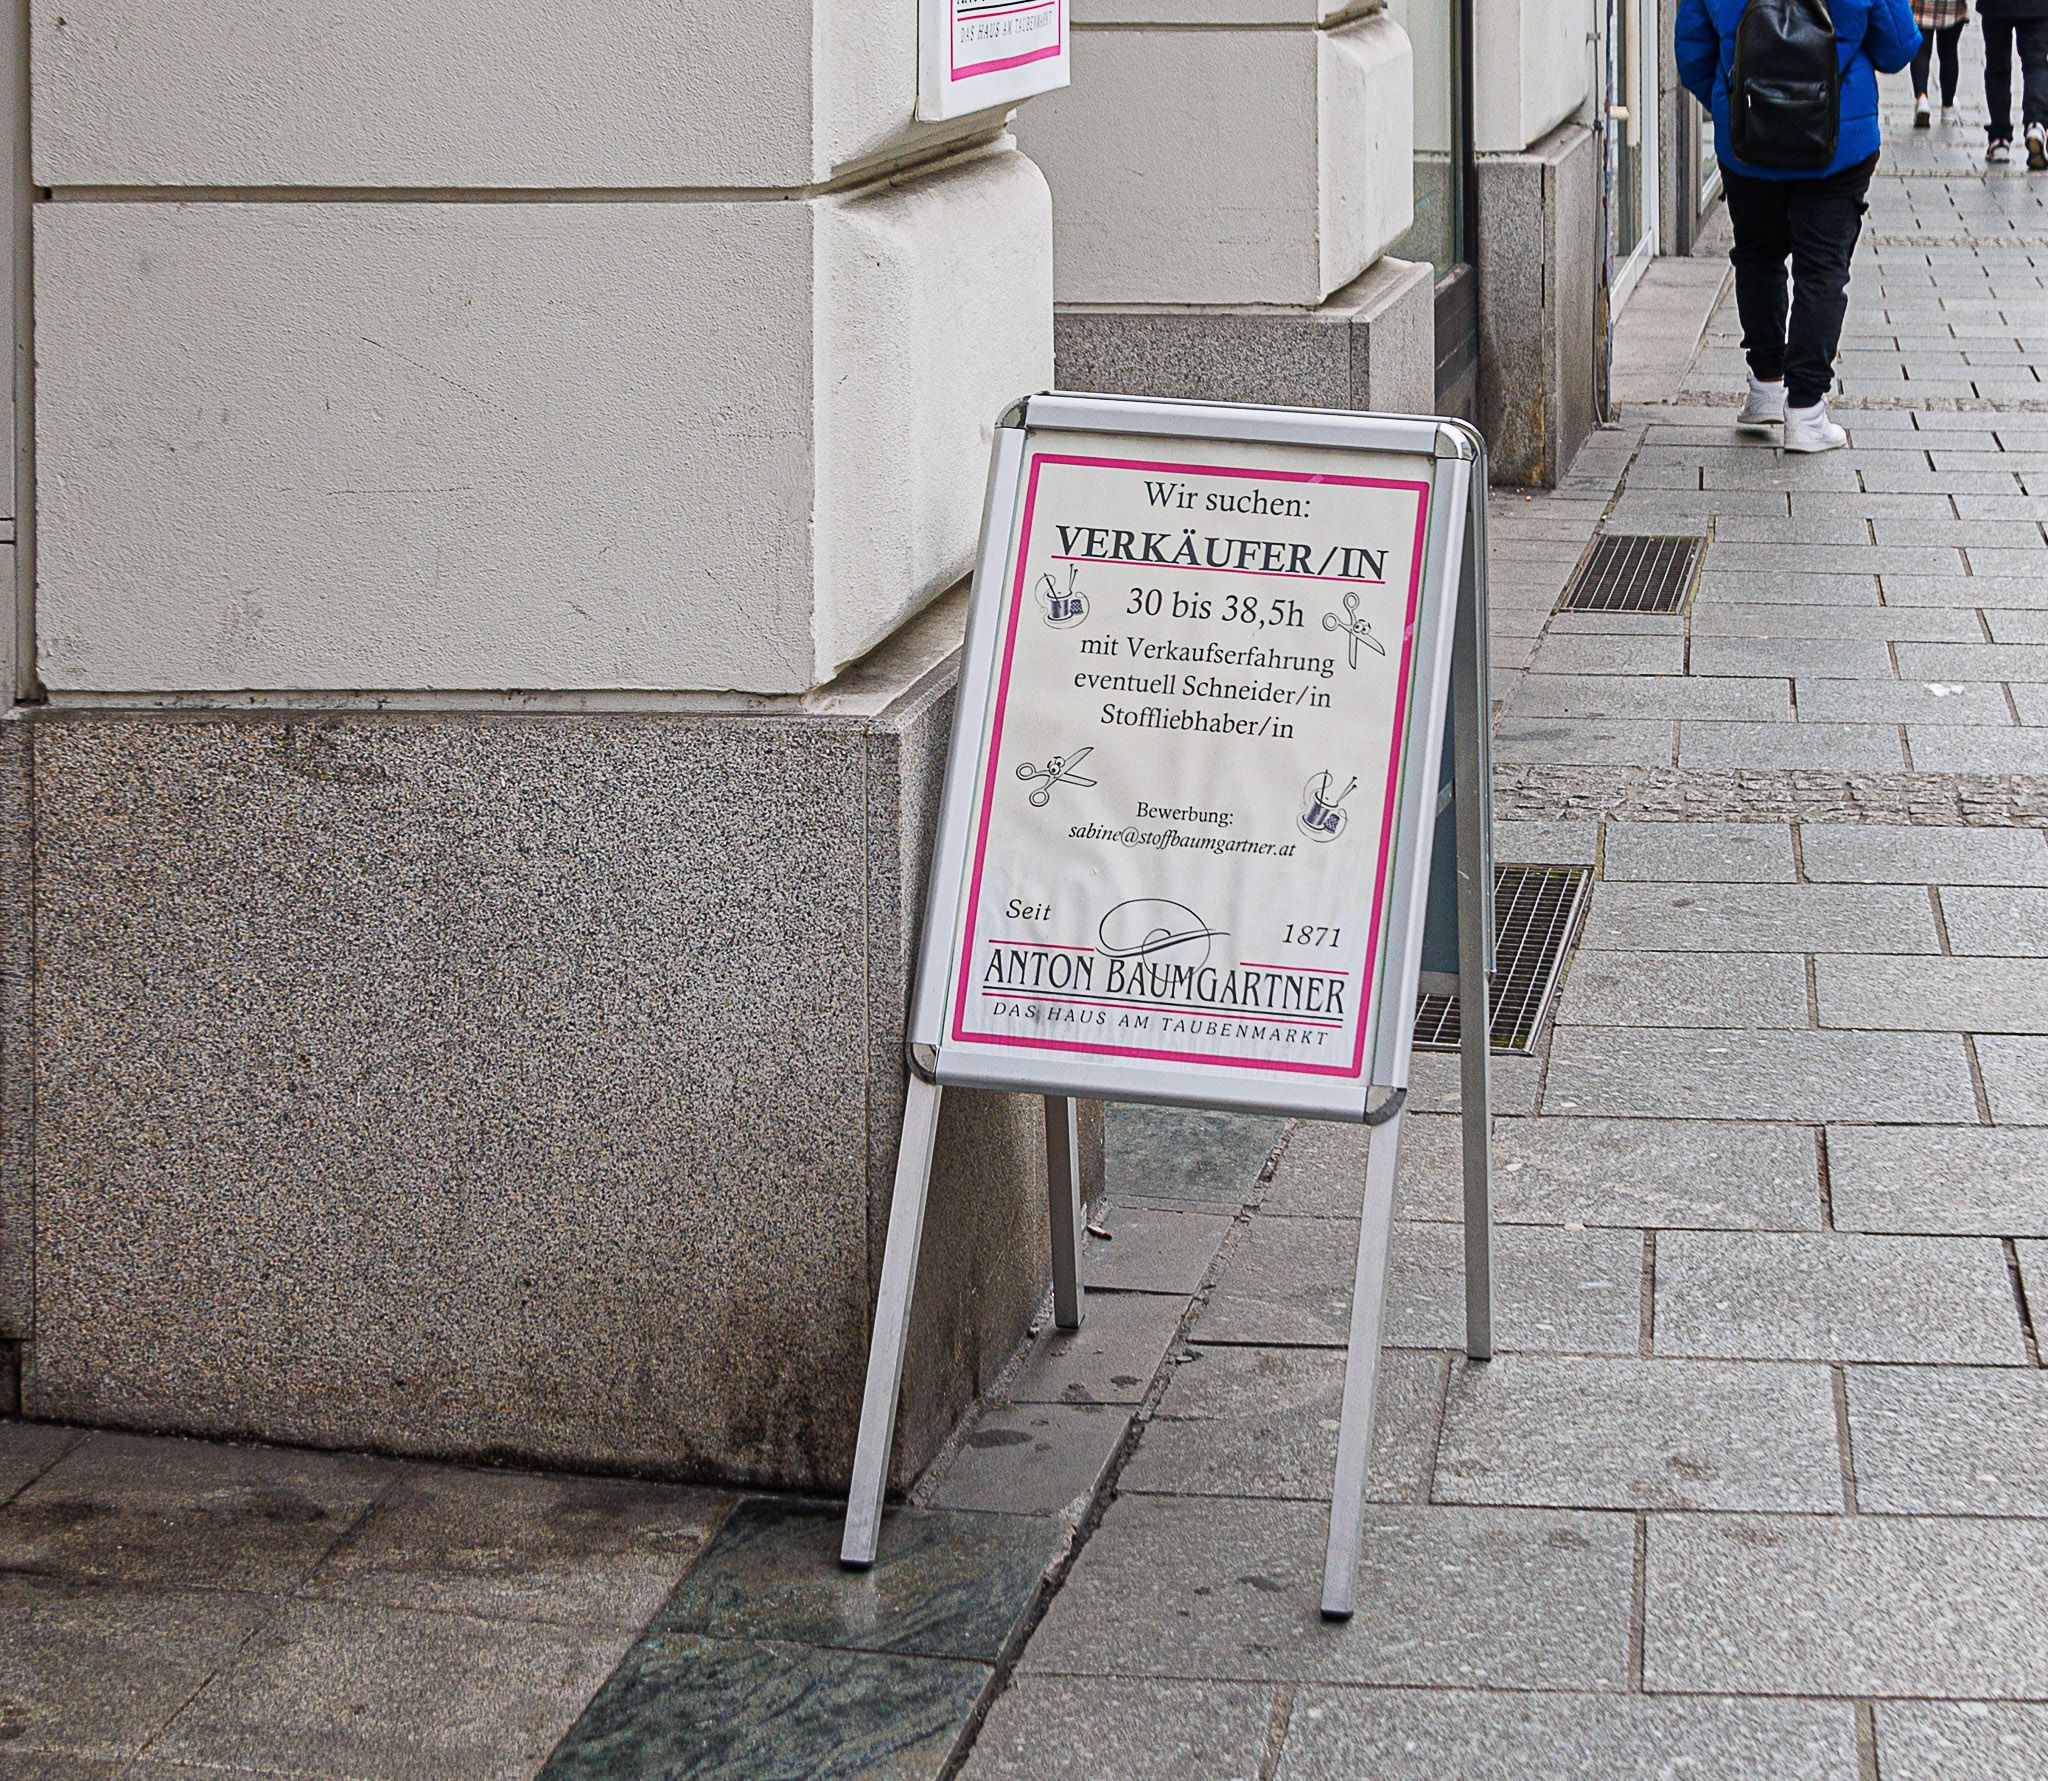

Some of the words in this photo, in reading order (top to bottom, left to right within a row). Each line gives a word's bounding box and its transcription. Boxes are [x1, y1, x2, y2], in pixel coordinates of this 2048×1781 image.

[960, 25, 975, 43] DAS
[977, 21, 1000, 41] HAUS
[1144, 480, 1198, 509] Wir
[1206, 488, 1311, 518] suchen:
[1055, 524, 1389, 580] VERKÄUFER/IN
[1126, 587, 1163, 616] 30
[1172, 589, 1212, 620] bis
[1221, 594, 1305, 630] 38,5h
[1080, 635, 1119, 657] mit
[1126, 636, 1335, 677] Verkaufserfahrung
[1074, 671, 1176, 695] eventuell
[1182, 675, 1332, 708] Schneider/in
[1100, 704, 1294, 739] Stoffliebhaber/in
[1136, 801, 1234, 827] Bewerbung:
[1068, 822, 1297, 858] sabine@stoffbaumgartner.at
[1005, 899, 1051, 922] Seit
[1283, 923, 1342, 949] 1871
[983, 948, 1095, 992] ANTON
[1105, 958, 1346, 1015] BAUMGARTNER
[993, 1001, 1037, 1019] DAS
[1047, 1007, 1107, 1026] HAUS
[1118, 1013, 1149, 1030] AM
[1162, 1017, 1330, 1046] TAUBENMARKT
